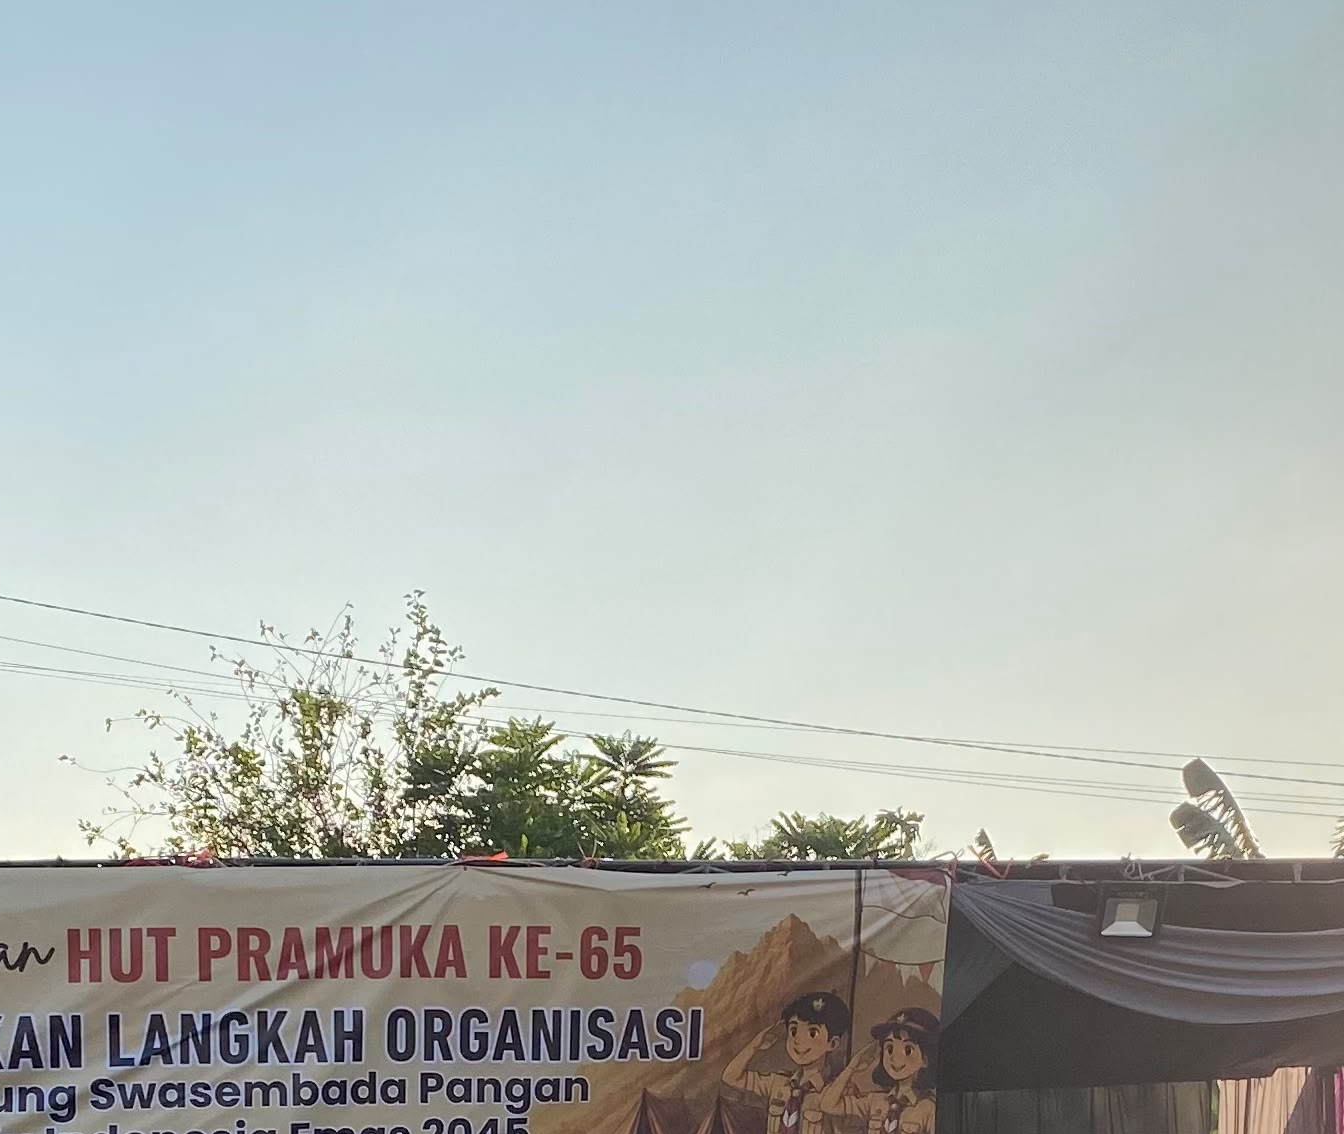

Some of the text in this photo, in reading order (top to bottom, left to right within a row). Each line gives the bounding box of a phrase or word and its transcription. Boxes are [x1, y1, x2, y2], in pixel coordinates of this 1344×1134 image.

[67, 927, 177, 983] HUT
[197, 924, 467, 982] PRAMUKA
[489, 925, 643, 980] KE-65
[108, 1009, 363, 1067] LANGKAH
[386, 1008, 703, 1061] ORGANISASI
[90, 1071, 407, 1110] Swasembada
[419, 1073, 589, 1115] Pangan
